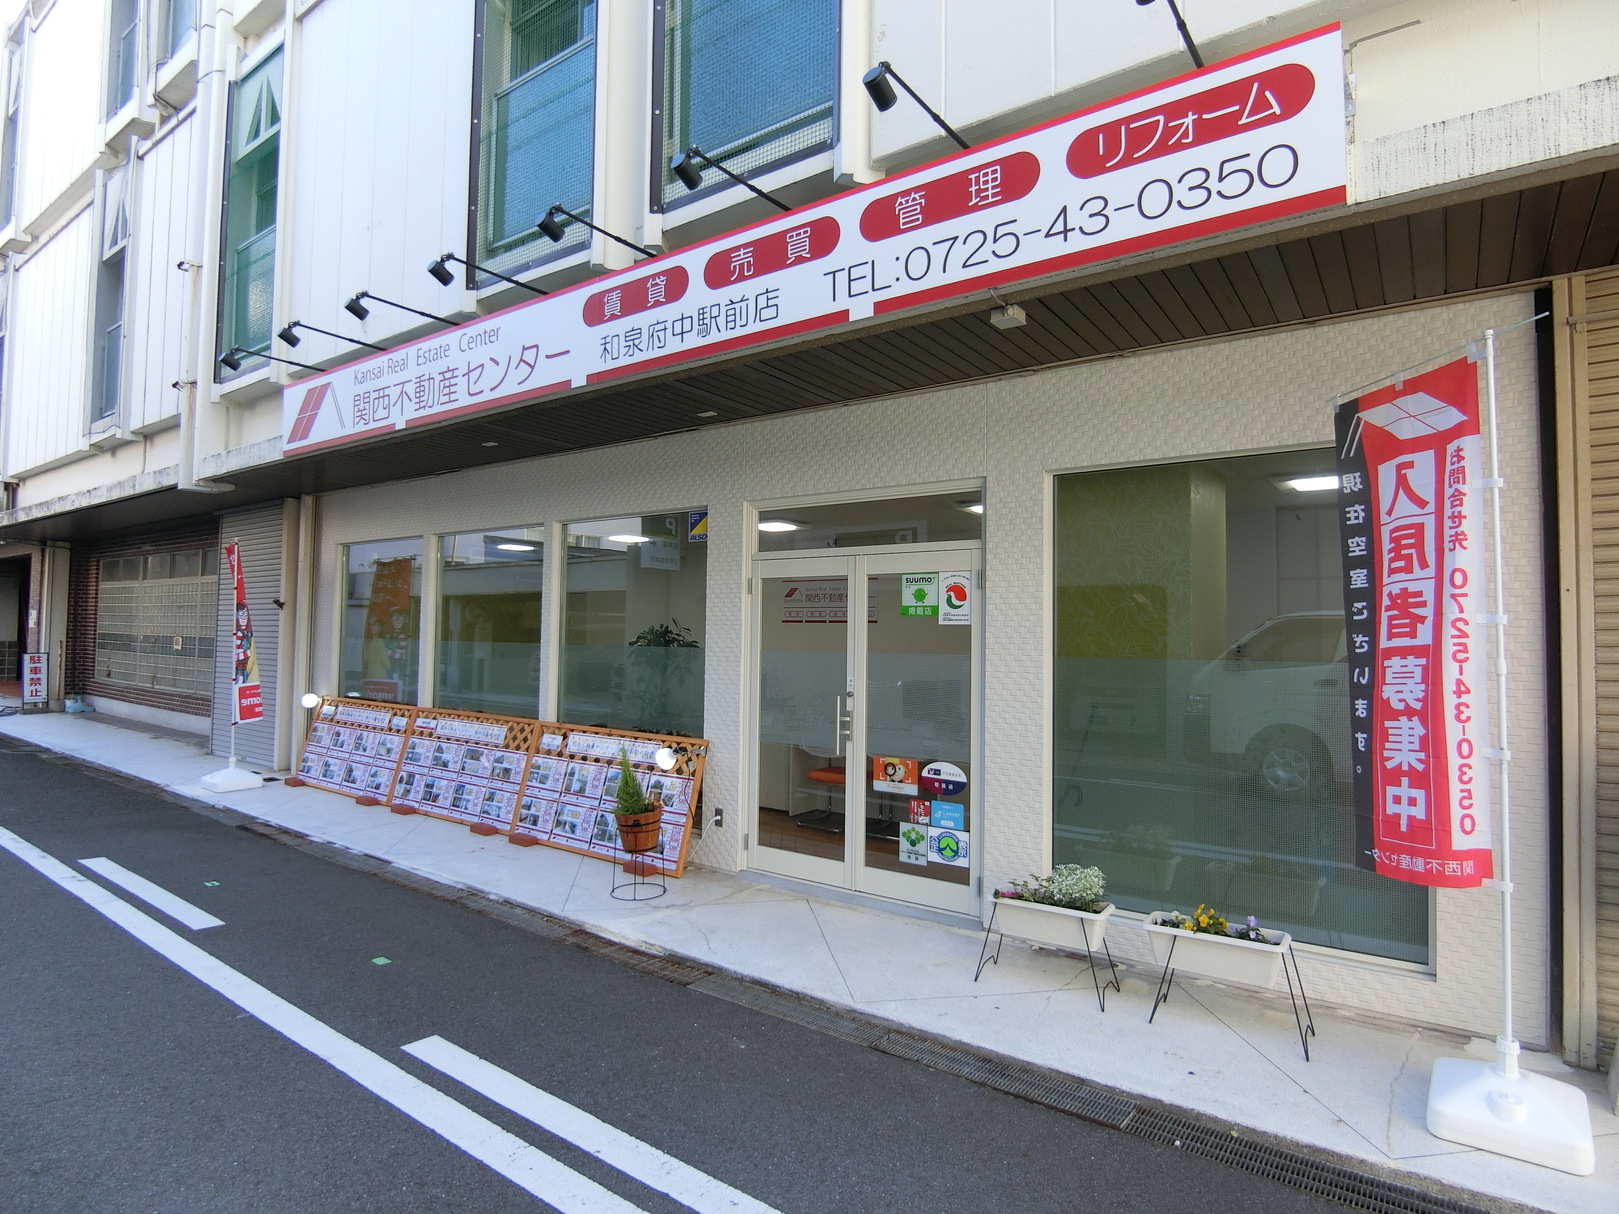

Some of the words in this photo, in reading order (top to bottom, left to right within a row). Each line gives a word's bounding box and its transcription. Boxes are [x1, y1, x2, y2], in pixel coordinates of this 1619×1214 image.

[1098, 81, 1281, 168] リフォーム
[894, 164, 1004, 231] 管理
[729, 227, 811, 282] 売買
[600, 288, 781, 364] 和泉府中駅前店
[602, 278, 667, 321] 賃貸
[351, 342, 571, 428] 関西不動産センター
[353, 362, 386, 386] Kansai
[386, 352, 409, 374] Real
[416, 341, 451, 365] Estate
[459, 325, 502, 352] Center
[30, 655, 43, 698] 駐車禁止
